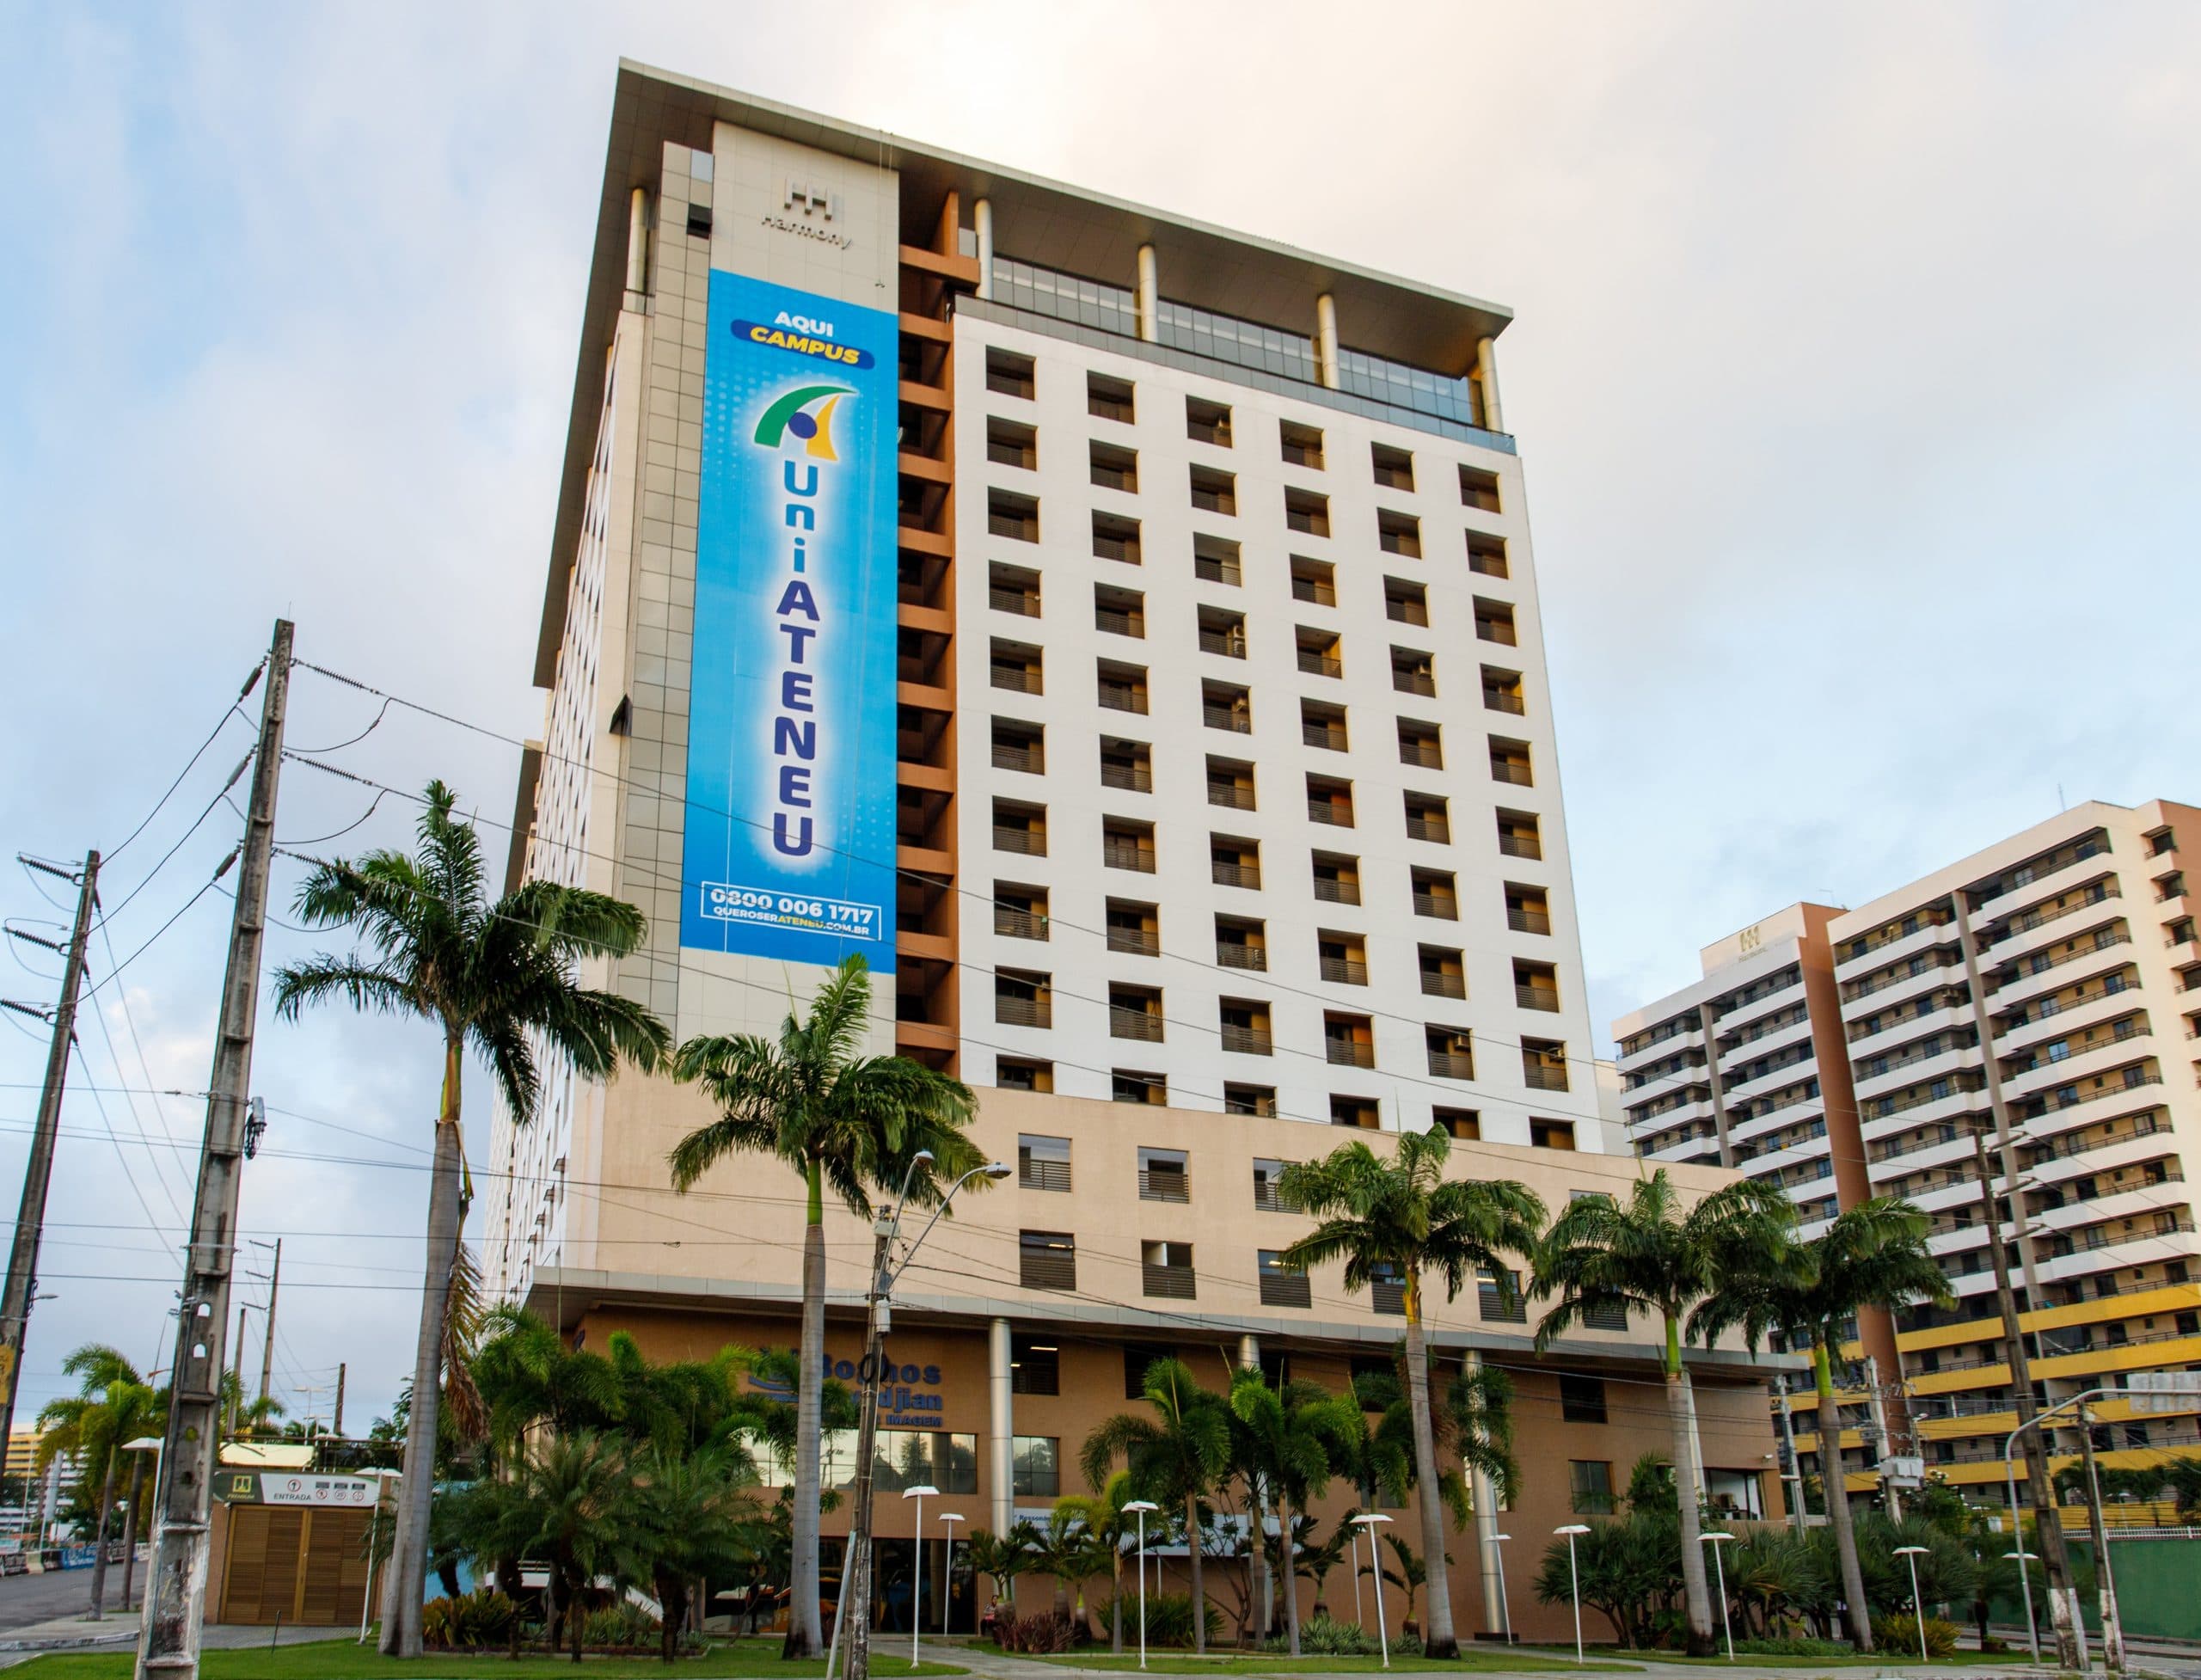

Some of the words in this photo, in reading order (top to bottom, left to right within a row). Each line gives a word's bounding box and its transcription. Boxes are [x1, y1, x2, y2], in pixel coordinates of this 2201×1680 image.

[775, 311, 833, 337] AQUI
[750, 326, 860, 365] CAMPUS
[710, 888, 772, 910] 0800
[778, 899, 823, 917] 006
[829, 904, 874, 924] 1717
[714, 905, 869, 935] QUEROSERATENEU.COM.BR
[886, 1414, 942, 1427] IMAGEM
